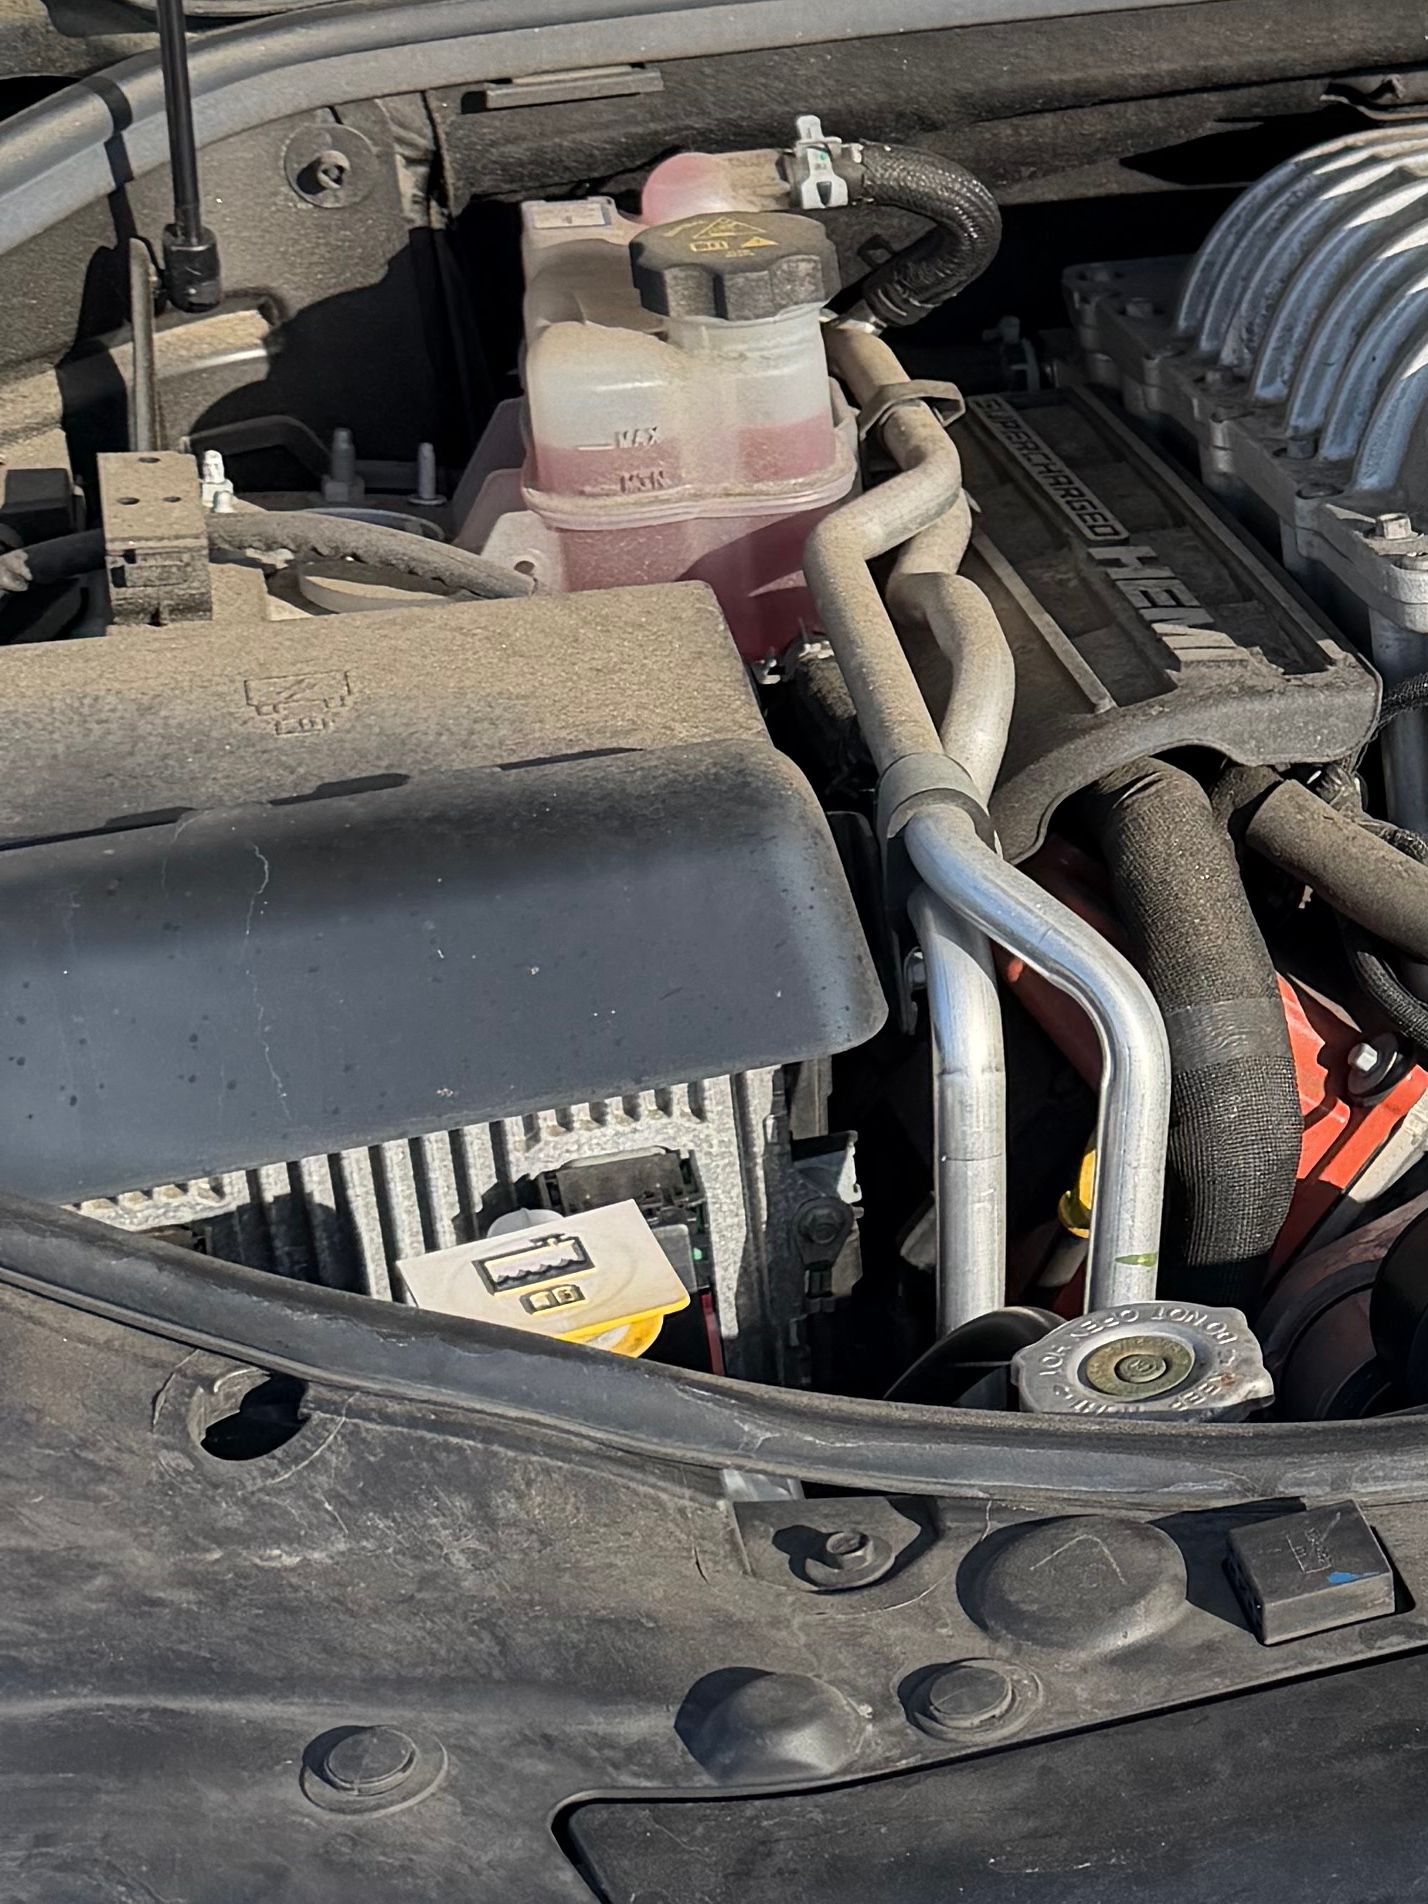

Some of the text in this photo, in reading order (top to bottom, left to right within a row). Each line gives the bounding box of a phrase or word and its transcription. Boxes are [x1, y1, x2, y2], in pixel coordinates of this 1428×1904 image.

[975, 400, 1122, 538] SUPERCHARGED
[1069, 1309, 1140, 1338] OPEN
[1151, 1306, 1207, 1326] NOT
